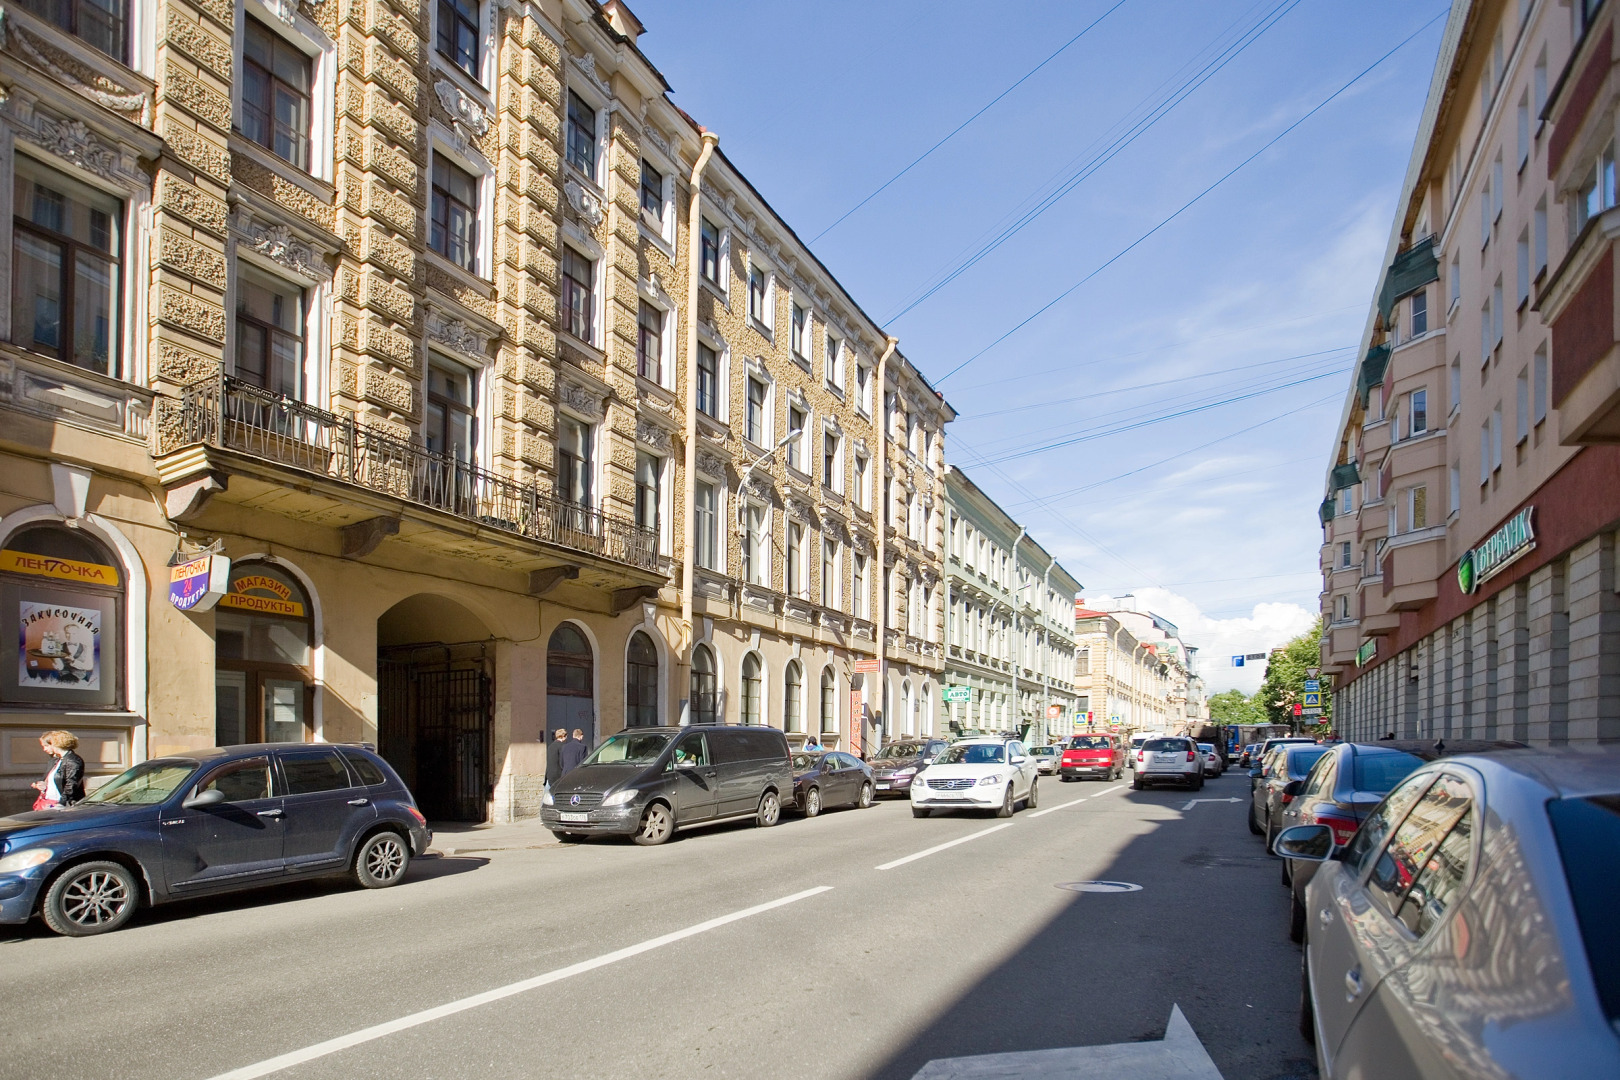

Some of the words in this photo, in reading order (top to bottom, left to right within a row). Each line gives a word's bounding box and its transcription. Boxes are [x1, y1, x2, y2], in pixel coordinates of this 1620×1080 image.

[1475, 507, 1532, 575] СБЕРБАНК
[16, 557, 104, 579] ЛЕНТОЧКА
[174, 560, 205, 579] ЛЕНТОЧКА
[171, 584, 205, 608] ПРОДУКТЫ
[183, 578, 192, 594] 24
[236, 577, 289, 598] МАГАЗИН
[230, 596, 295, 613] ПРОДУКТЫ
[22, 609, 99, 634] ЗАКУСОЧНАЯ
